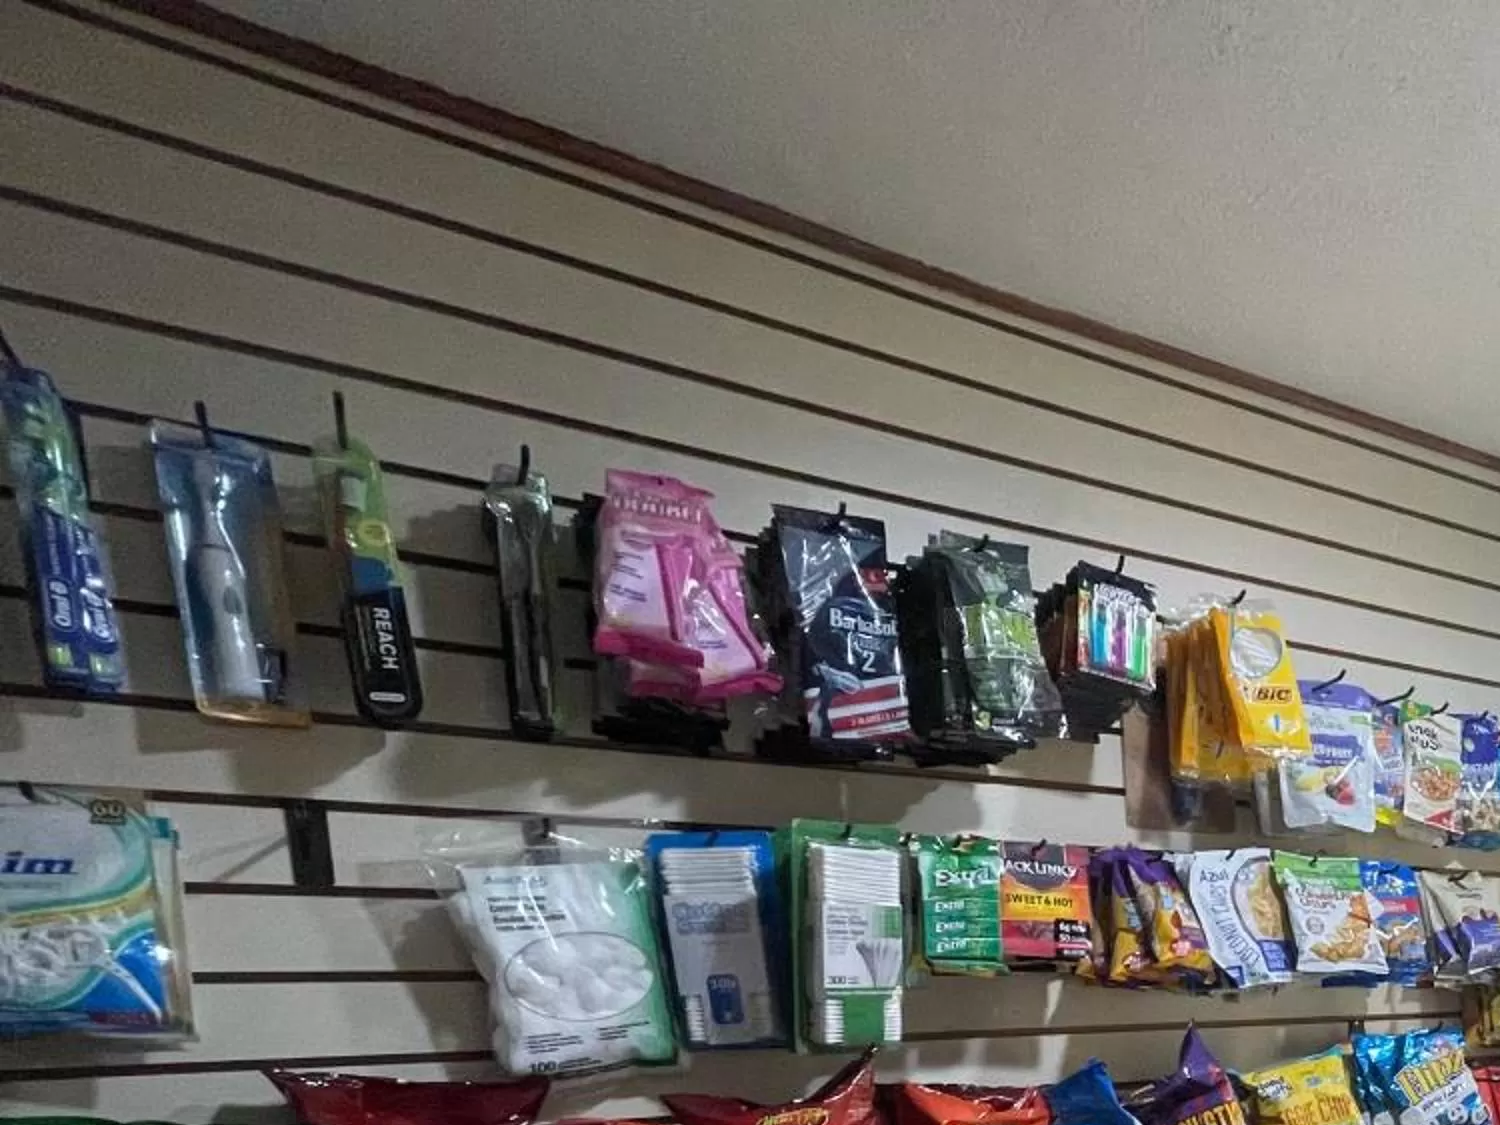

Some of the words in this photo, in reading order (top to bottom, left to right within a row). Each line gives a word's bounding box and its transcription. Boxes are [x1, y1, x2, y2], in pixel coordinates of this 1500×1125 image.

[371, 606, 400, 670] REACH
[862, 651, 877, 673] 2
[1255, 686, 1292, 702] BIC
